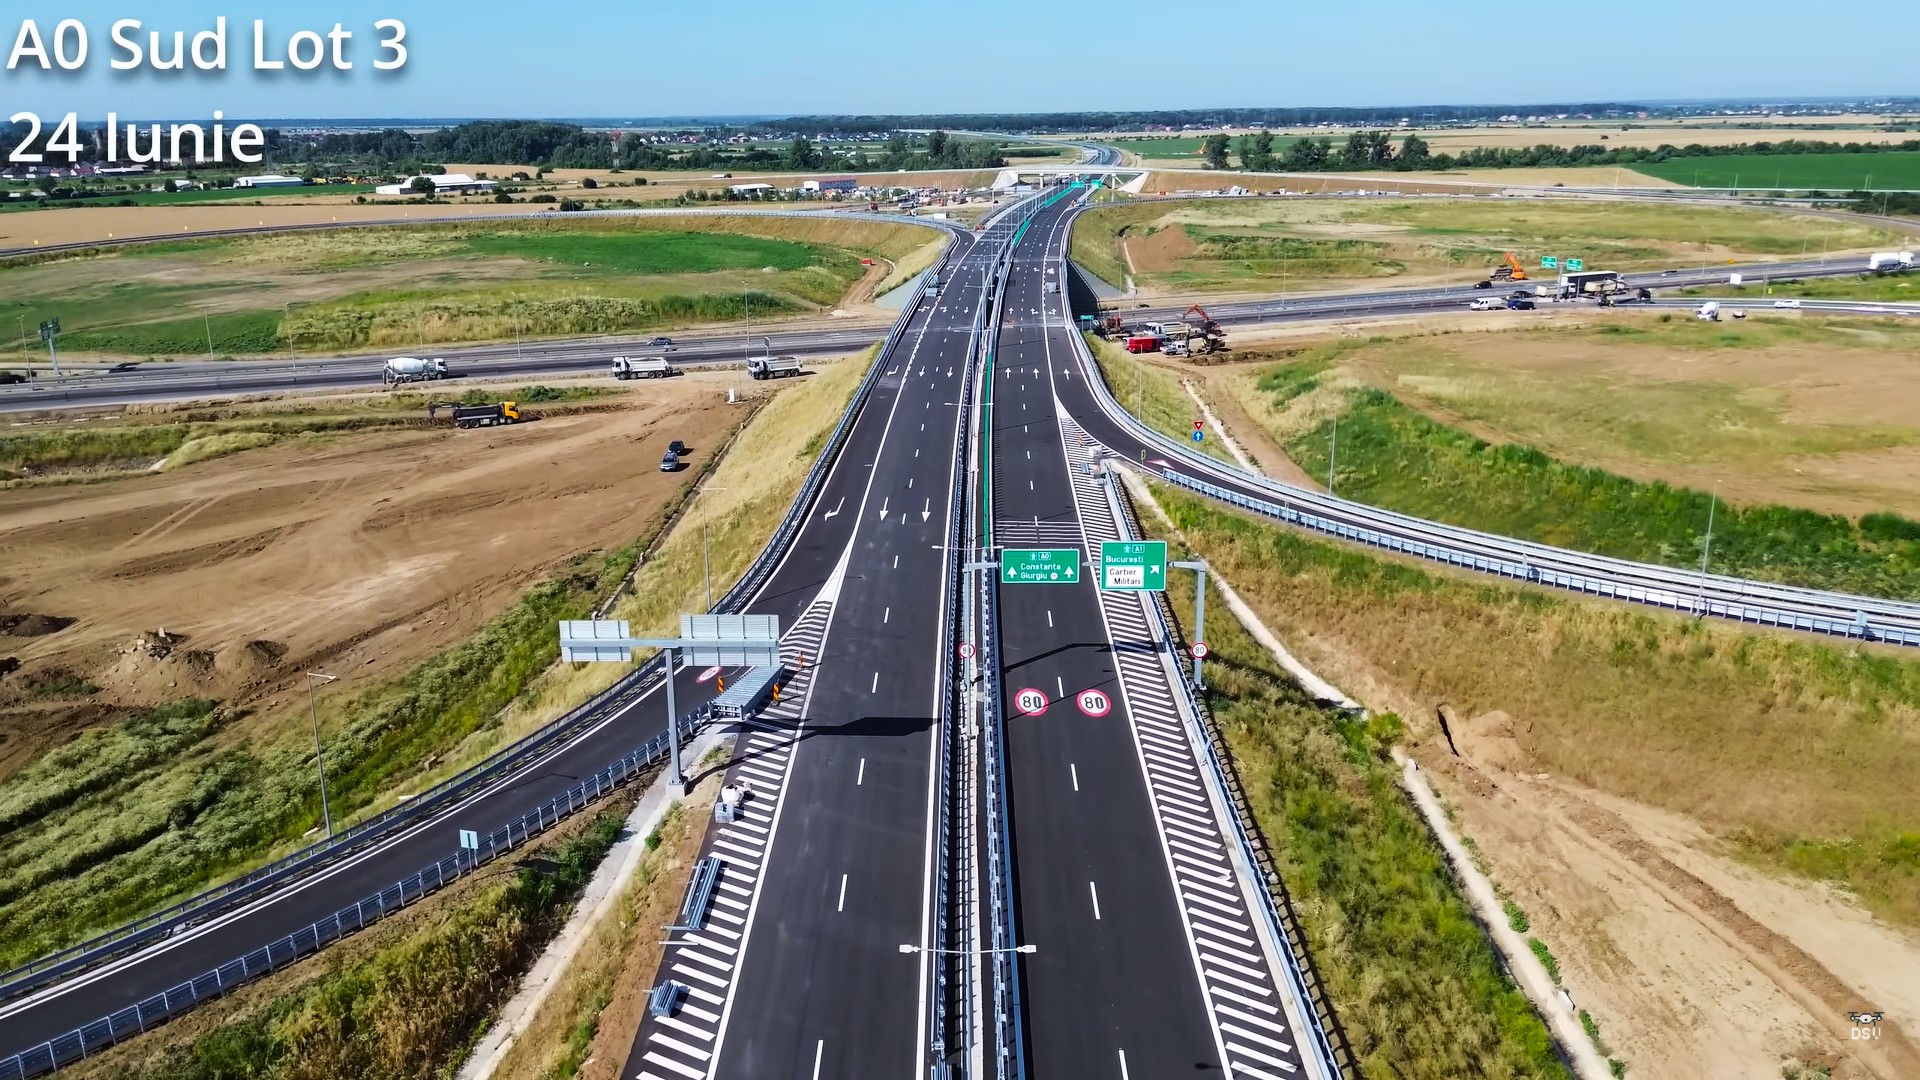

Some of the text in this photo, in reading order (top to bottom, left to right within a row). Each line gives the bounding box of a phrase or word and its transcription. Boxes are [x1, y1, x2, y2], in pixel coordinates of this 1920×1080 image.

[1020, 571, 1048, 581] Giurgiu
[1109, 568, 1137, 576] Cartier
[1113, 577, 1141, 585] Militari
[1195, 646, 1205, 655] 80
[1022, 696, 1042, 709] 80
[1084, 697, 1104, 709] 80
